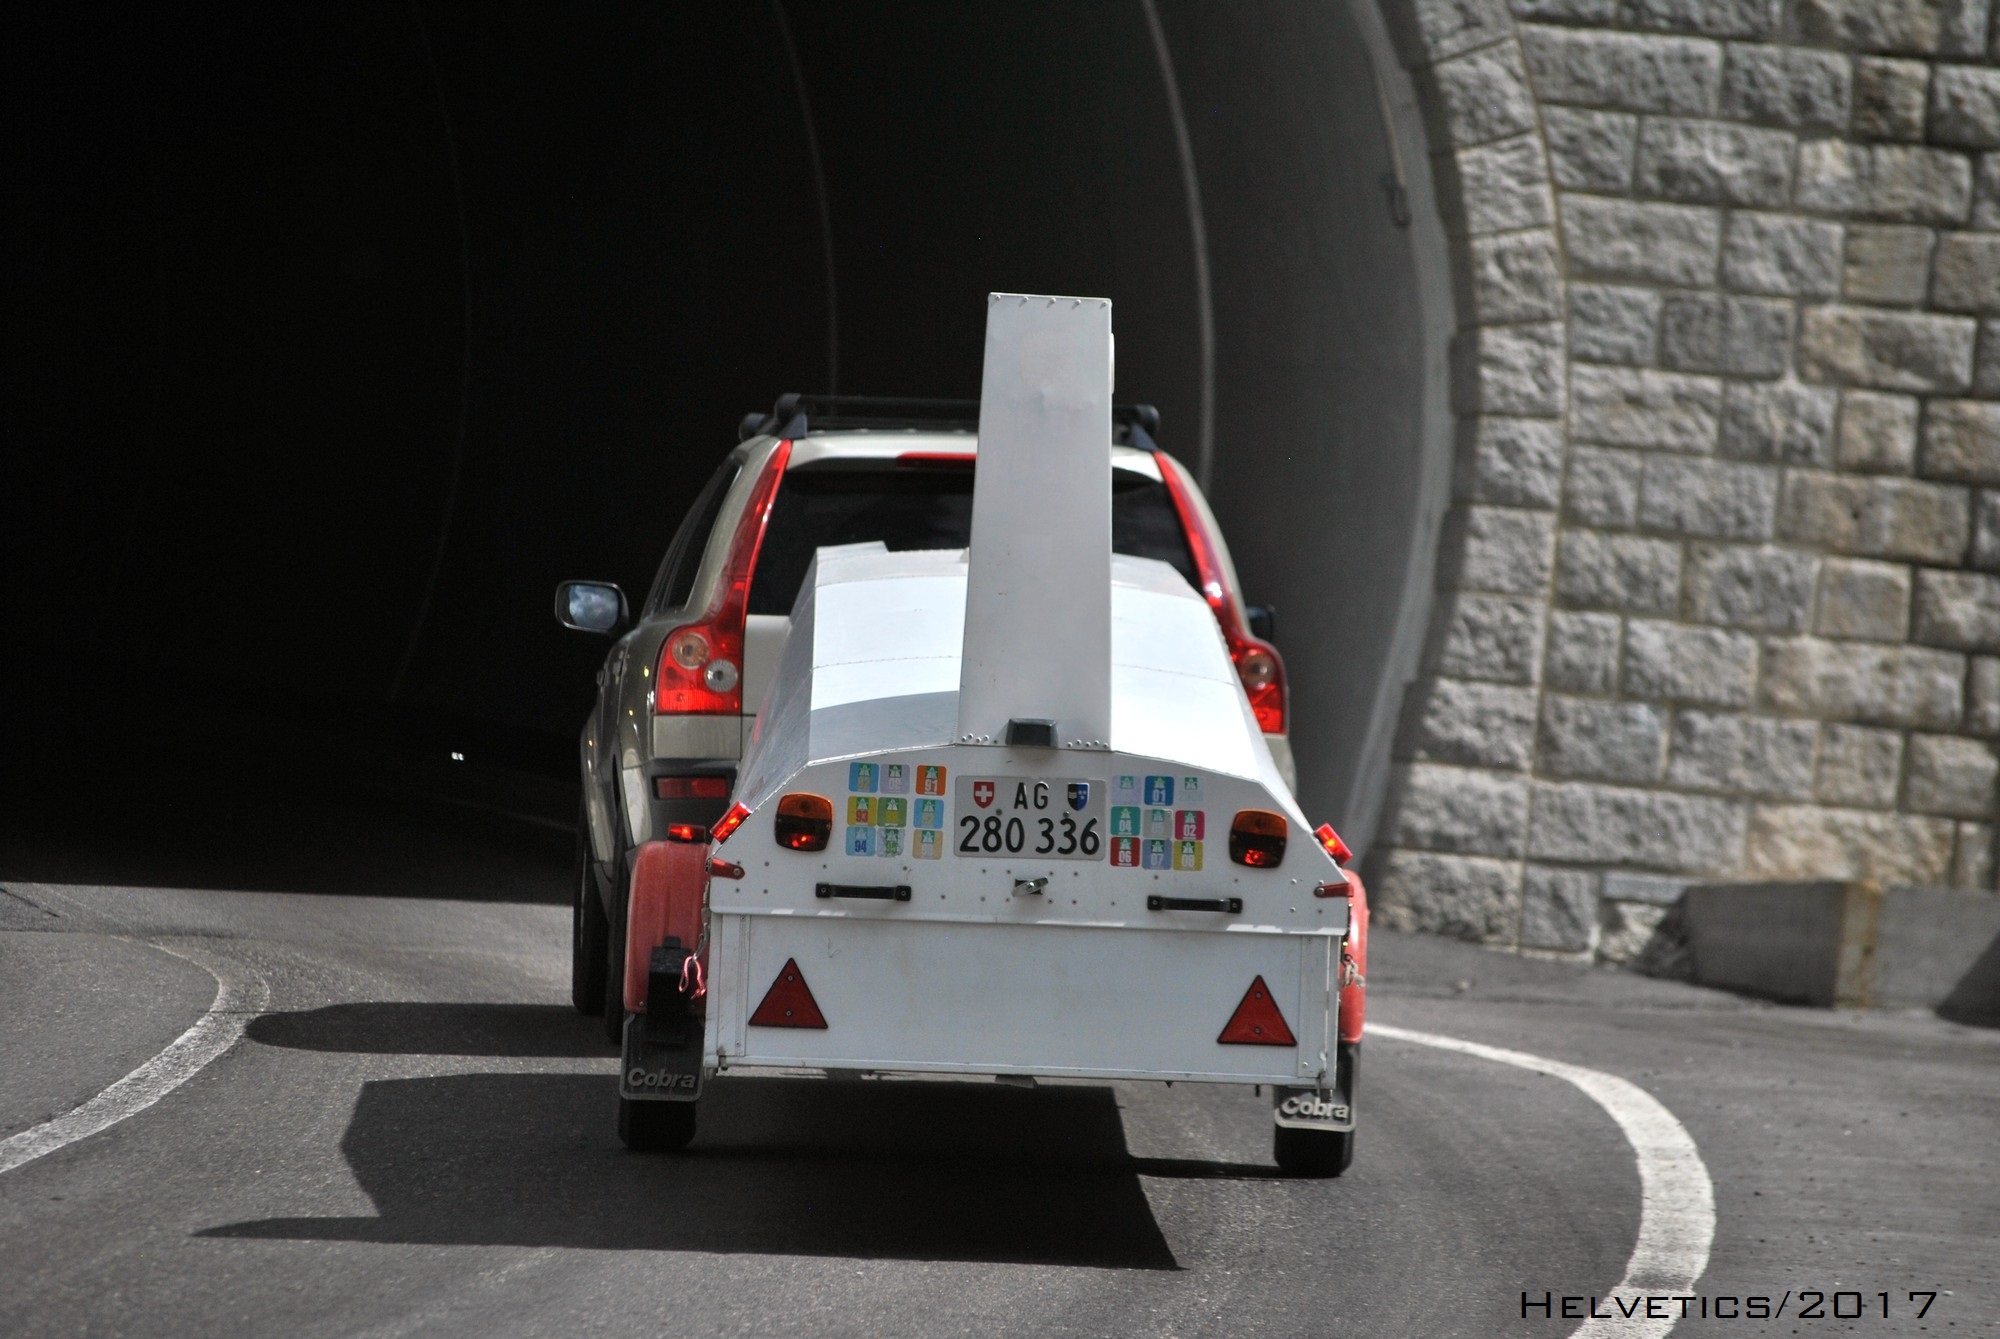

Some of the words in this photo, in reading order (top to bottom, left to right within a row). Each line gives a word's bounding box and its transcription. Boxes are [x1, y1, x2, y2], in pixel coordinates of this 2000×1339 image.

[925, 779, 938, 792] 91
[1013, 781, 1049, 810] AG
[1152, 789, 1166, 802] 01
[1119, 820, 1131, 832] 04
[1183, 825, 1196, 837] 02
[959, 815, 1025, 853] 280
[1035, 817, 1100, 855] 336
[855, 840, 867, 853] 94
[1119, 851, 1132, 863] 06
[1151, 853, 1164, 866] 07
[627, 1067, 696, 1089] Cobra
[1281, 1096, 1349, 1119] Cobra
